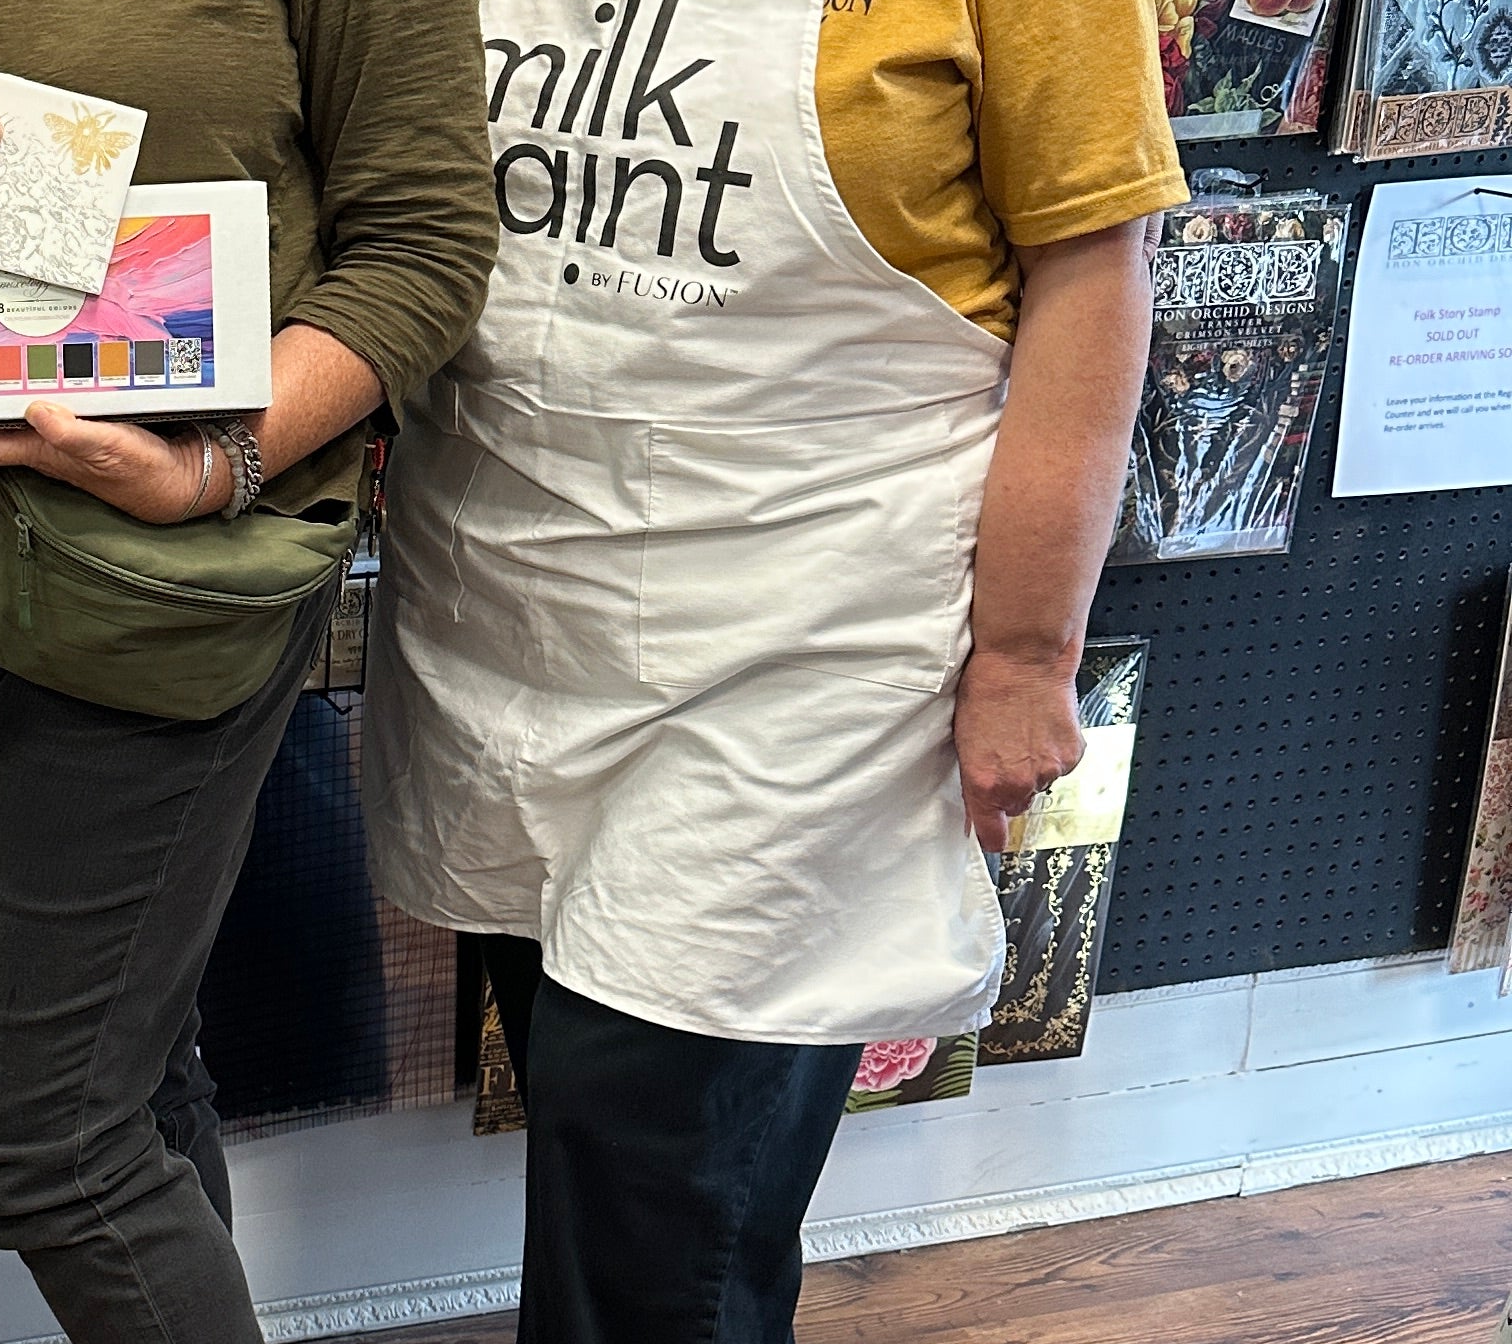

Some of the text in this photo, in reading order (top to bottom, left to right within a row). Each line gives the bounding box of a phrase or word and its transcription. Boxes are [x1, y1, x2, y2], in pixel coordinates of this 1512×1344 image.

[493, 121, 753, 268] aint
[591, 272, 612, 288] BY
[1191, 302, 1316, 319] ORCHID DESIGNS
[1414, 307, 1501, 321] Folk Story Stamp
[1200, 318, 1263, 329] TRANSFER
[1175, 326, 1283, 340] CRIMSON VELVET
[1426, 328, 1480, 343] SOLD OUT
[1389, 348, 1496, 366] RE-ORDER ARRIVING
[1410, 396, 1427, 406] your
[1429, 393, 1473, 403] information
[1484, 391, 1496, 399] the
[1385, 410, 1415, 419] Counter
[1417, 408, 1431, 417] and
[1461, 405, 1473, 413] call
[1475, 405, 1489, 414] you
[1384, 423, 1416, 432] Re-order
